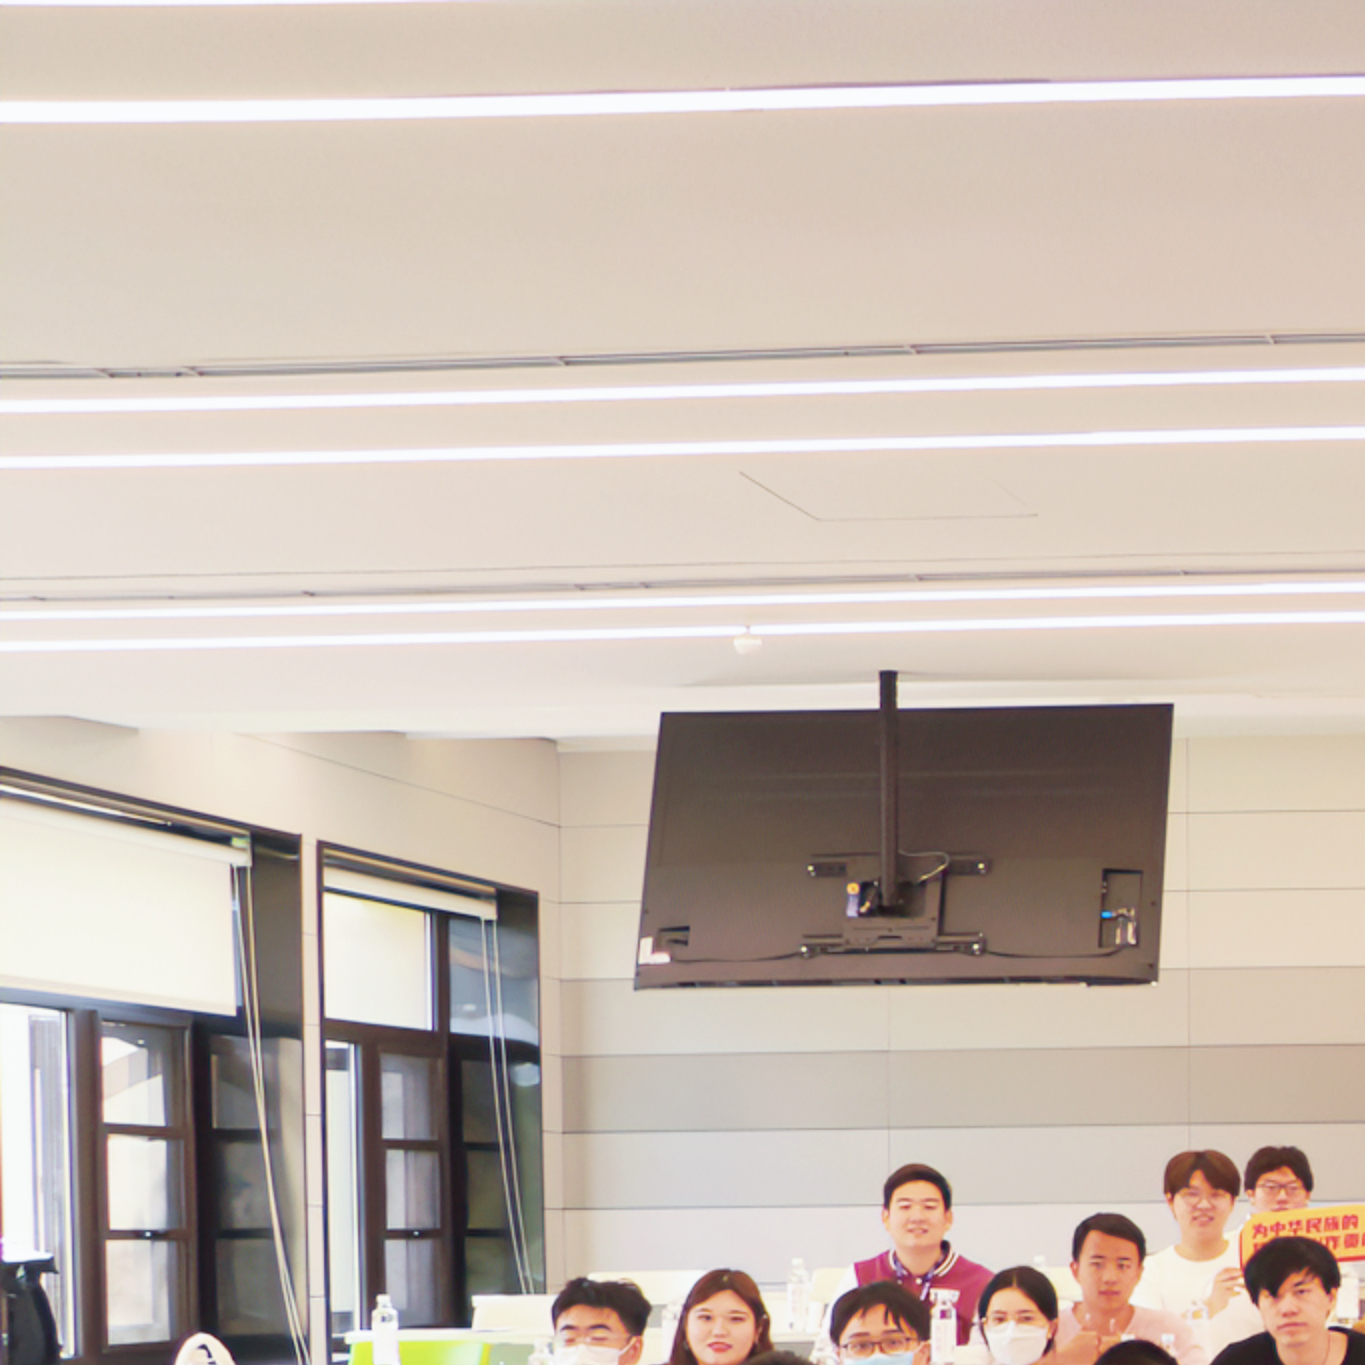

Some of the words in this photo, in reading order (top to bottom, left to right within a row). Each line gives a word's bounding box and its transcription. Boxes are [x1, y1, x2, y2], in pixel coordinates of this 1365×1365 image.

[1252, 1214, 1359, 1238] 为中华民族的
